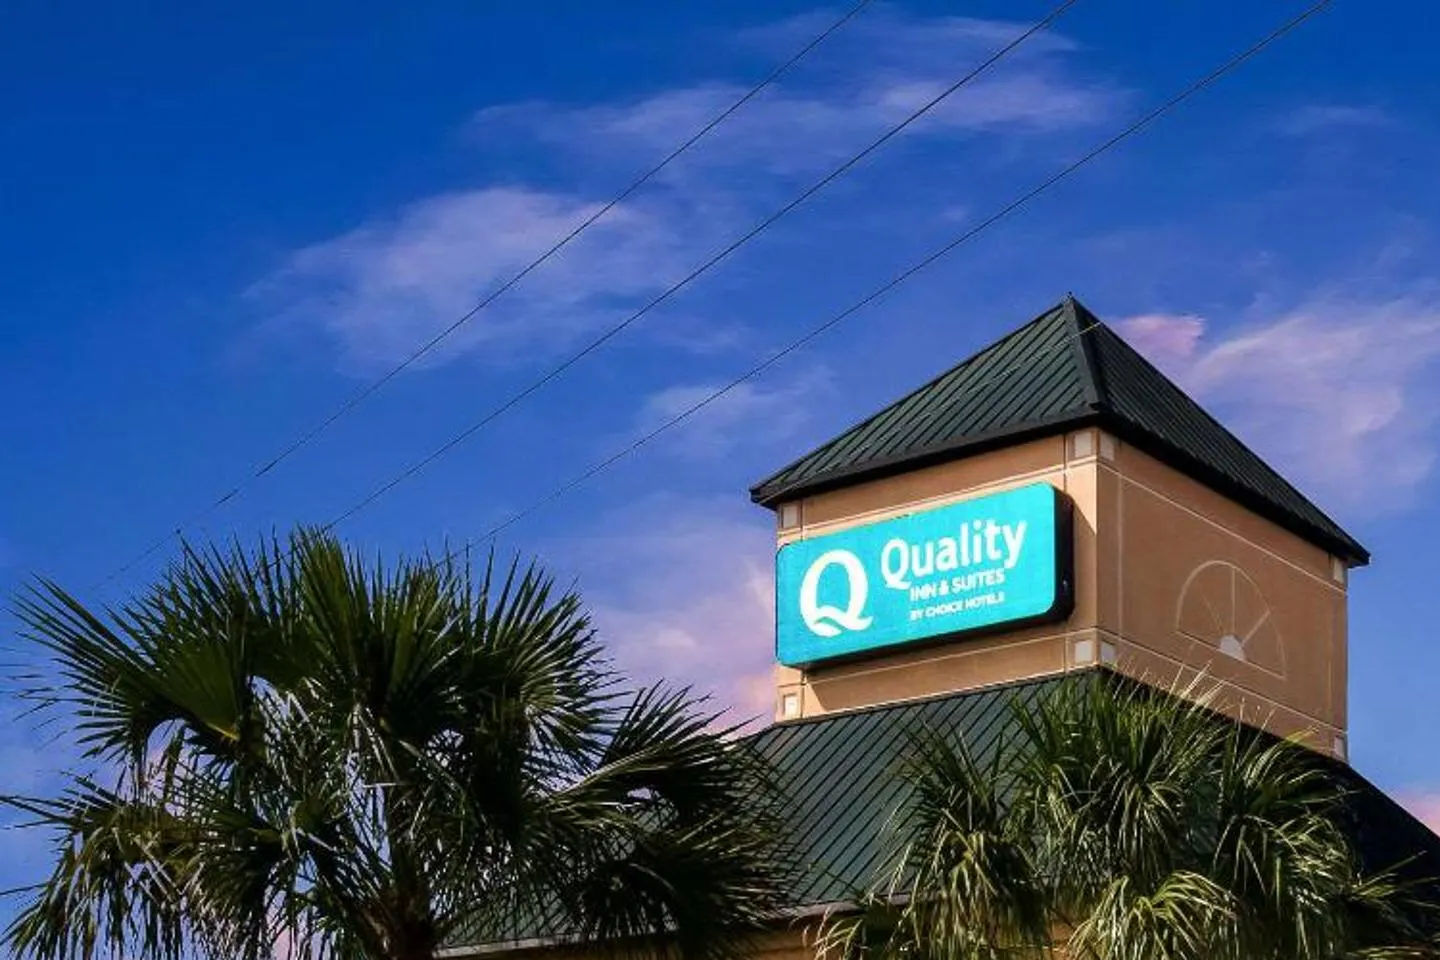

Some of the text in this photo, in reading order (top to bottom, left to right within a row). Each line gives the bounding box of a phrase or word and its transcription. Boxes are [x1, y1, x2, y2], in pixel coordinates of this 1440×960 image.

[881, 518, 1027, 590] Quality
[800, 549, 874, 638] Q
[909, 567, 1005, 602] INN & SUITES
[909, 591, 1005, 621] BY CHOICE HOTELS
